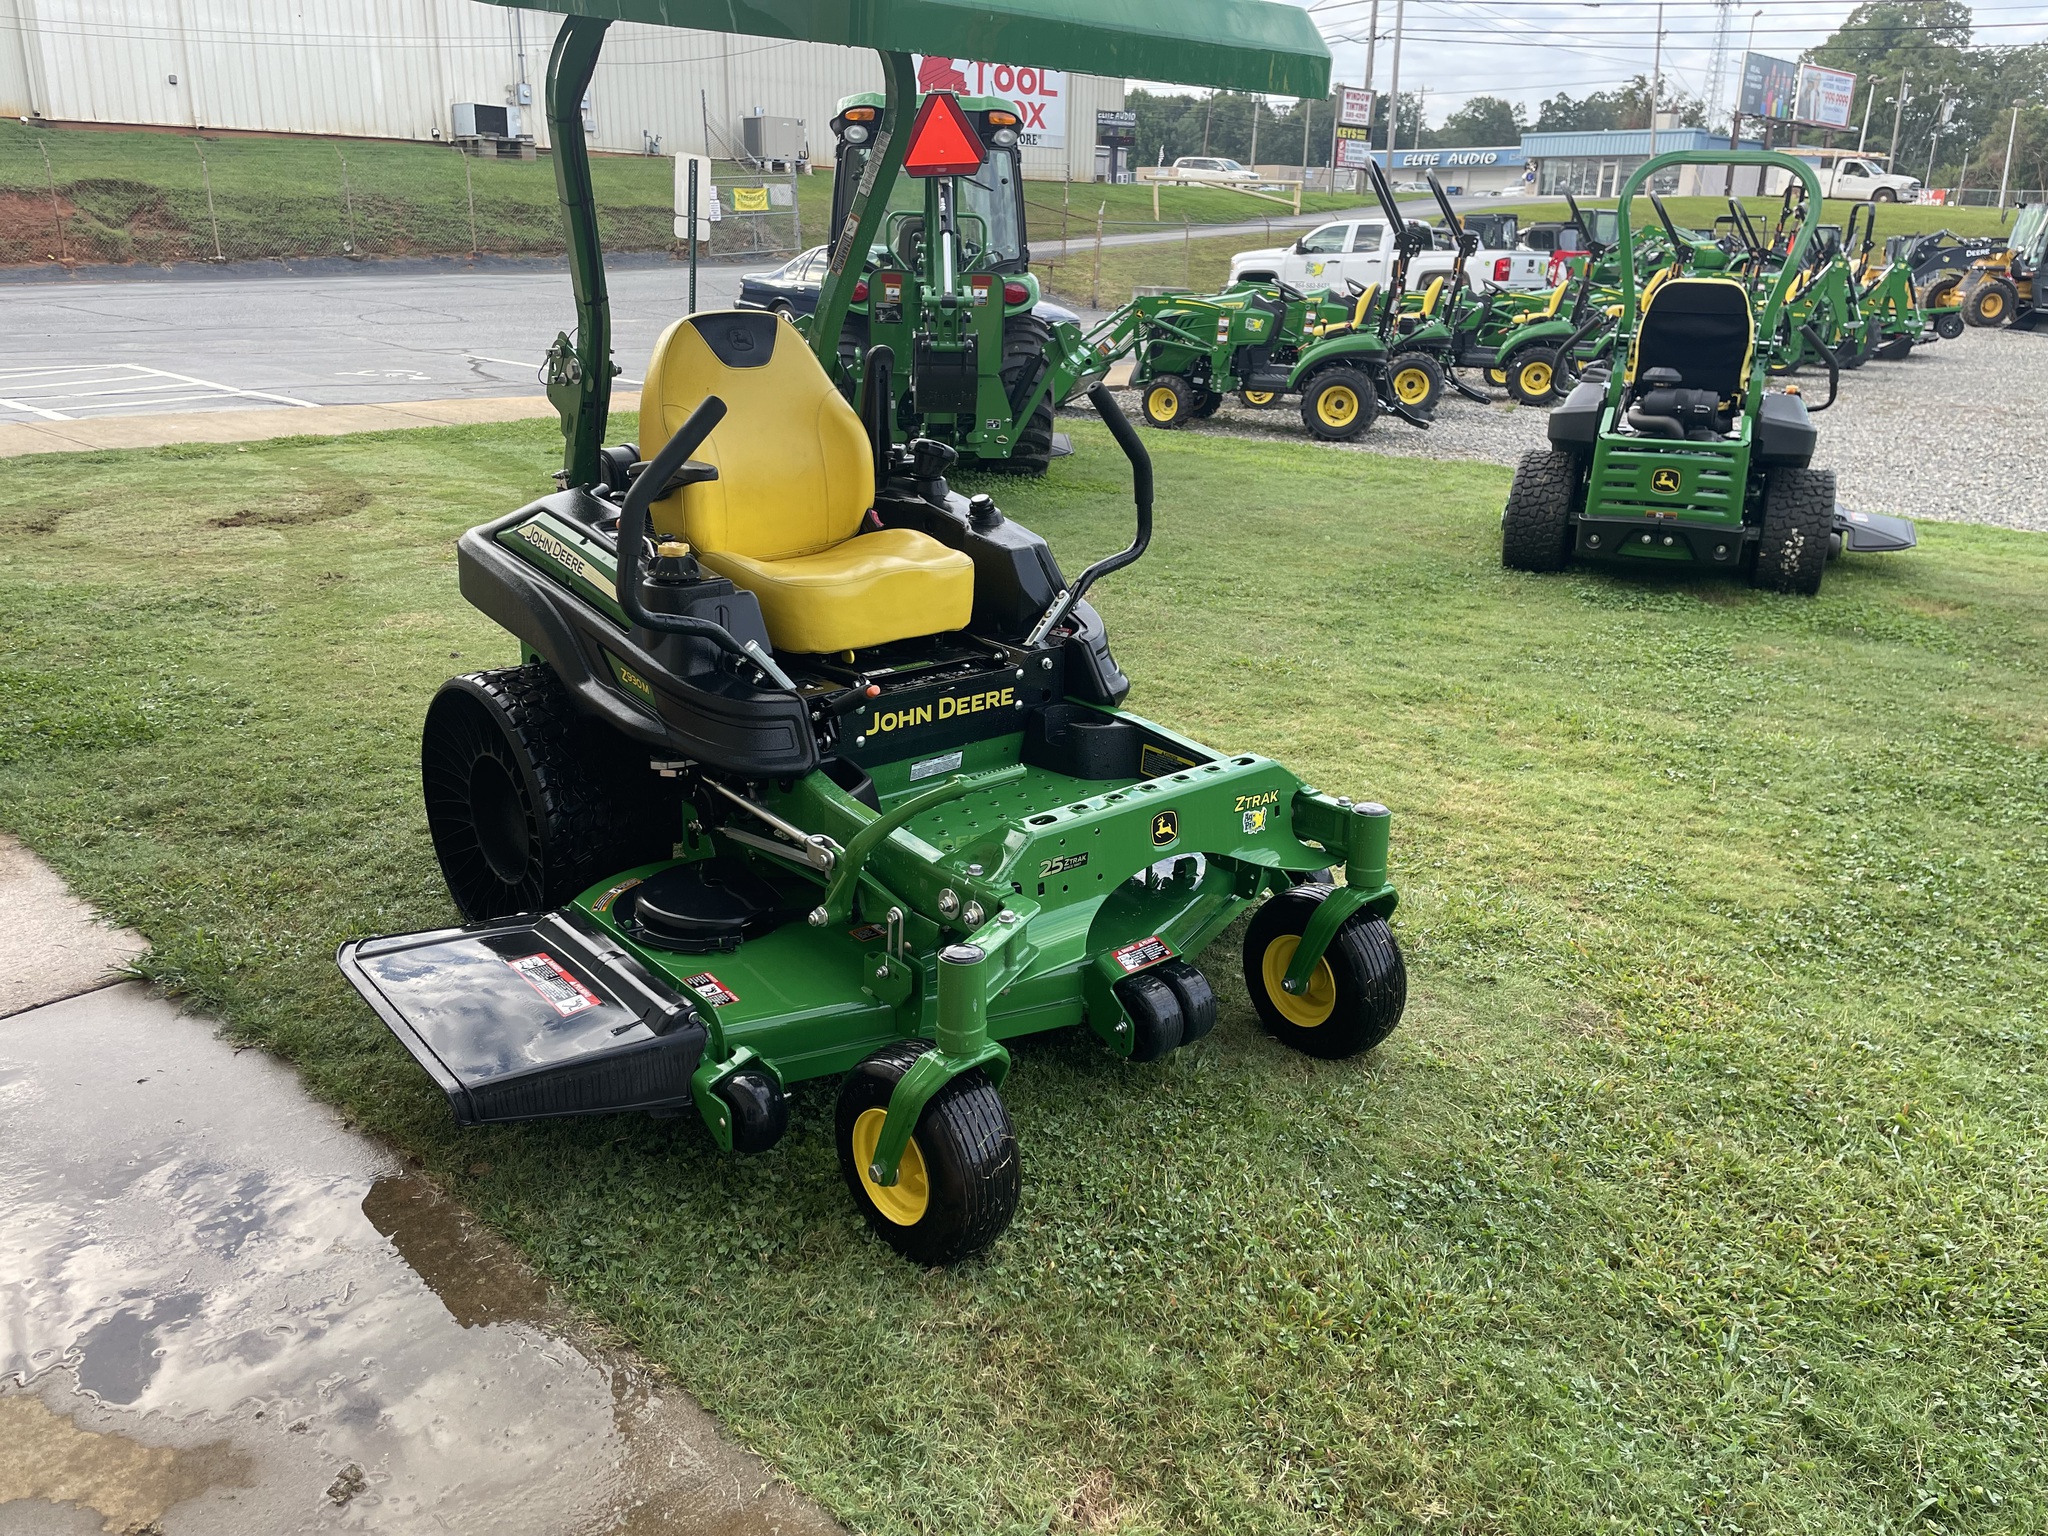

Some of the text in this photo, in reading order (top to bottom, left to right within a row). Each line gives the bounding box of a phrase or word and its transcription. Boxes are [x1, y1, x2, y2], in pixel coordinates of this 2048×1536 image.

[967, 61, 1058, 97] TOOL
[1345, 92, 1370, 102] WINDOW
[1345, 102, 1368, 112] TINTING
[1115, 112, 1136, 120] AUDIO
[1020, 134, 1037, 145] ORE
[1337, 127, 1358, 139] KEYS
[1403, 154, 1440, 165] ELITE
[1447, 152, 1497, 164] AUDIO
[1966, 249, 1990, 257] DEERE
[526, 527, 585, 575] JOHN DEERE
[620, 667, 650, 695] Z930M
[866, 687, 1015, 736] JOHN DEERE
[1234, 789, 1279, 812] ZTRAK
[1039, 855, 1087, 878] 25 ZTRAK
